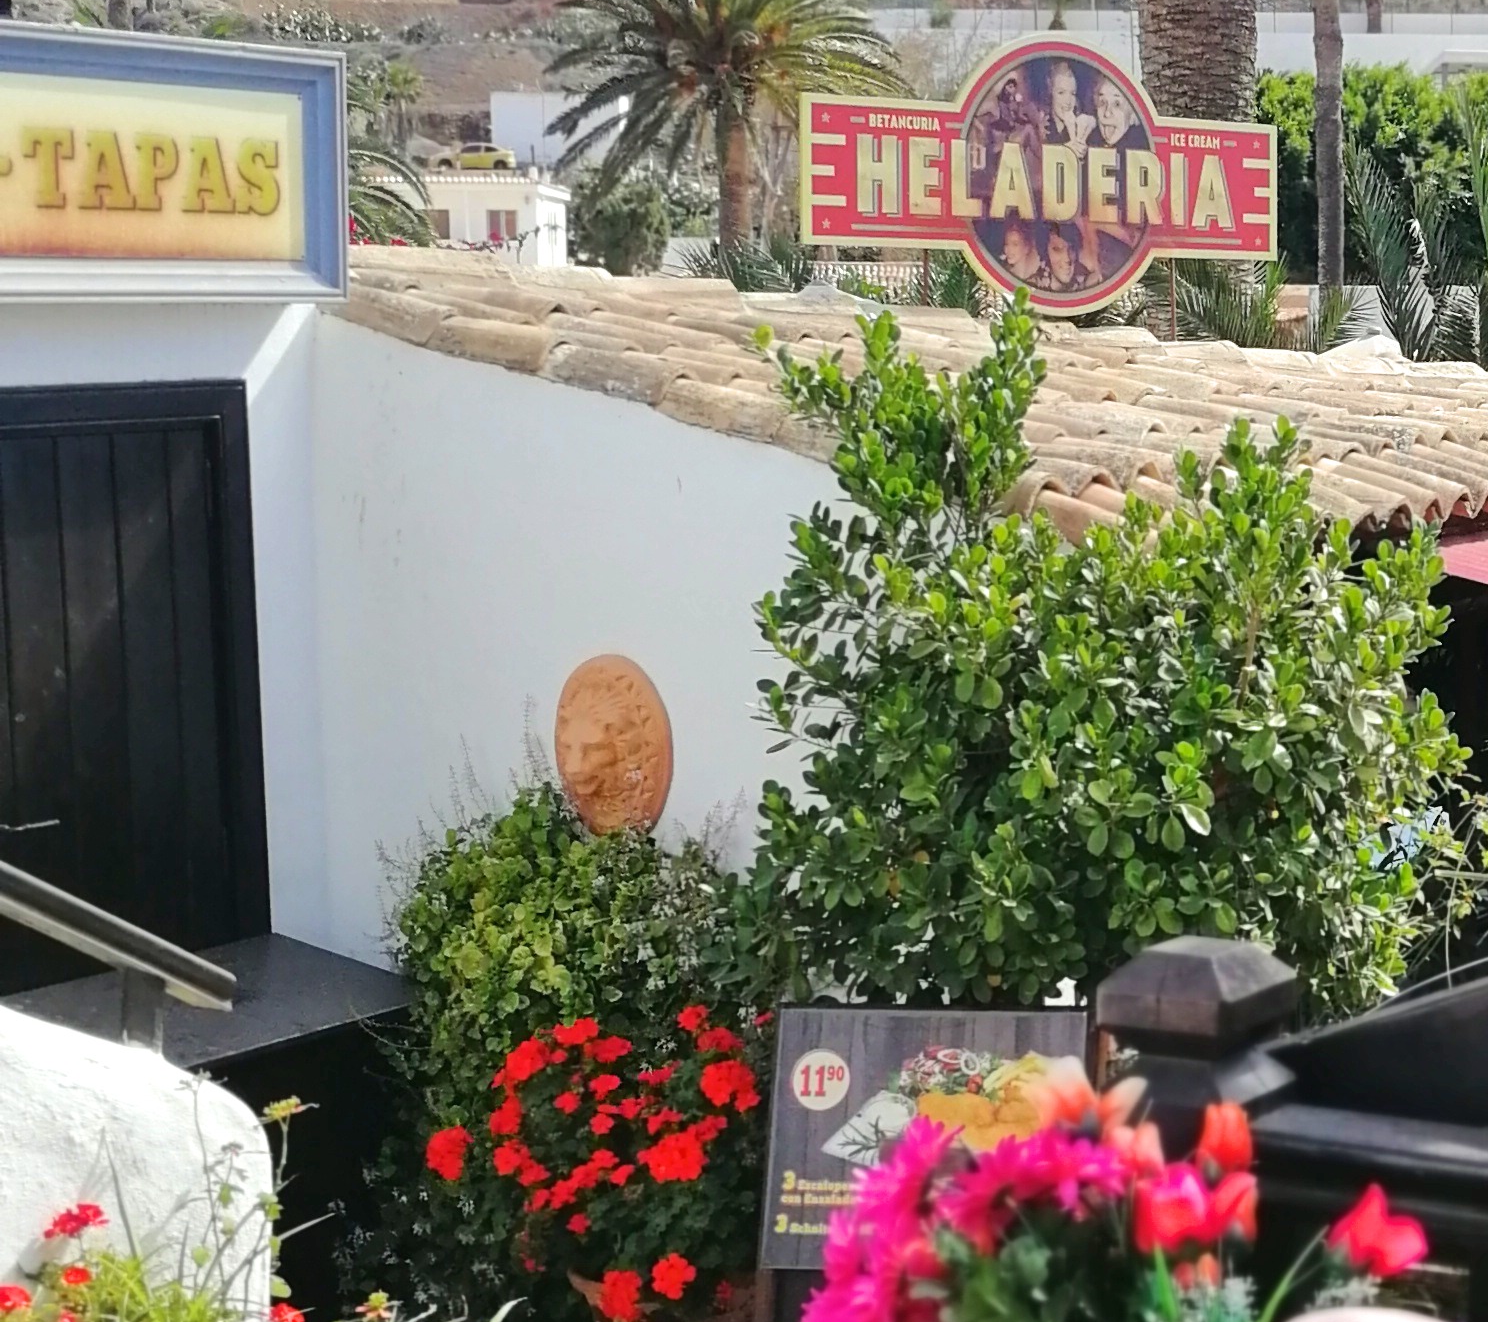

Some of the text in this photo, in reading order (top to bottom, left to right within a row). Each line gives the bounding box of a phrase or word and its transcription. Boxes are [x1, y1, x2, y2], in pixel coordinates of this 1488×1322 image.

[868, 113, 941, 132] BETANCURIA
[1170, 133, 1221, 150] ICE CREAM
[21, 125, 281, 217] TAPAS
[856, 133, 1237, 233] HELADERIA
[783, 1170, 796, 1191] 3
[774, 1213, 788, 1233] 3
